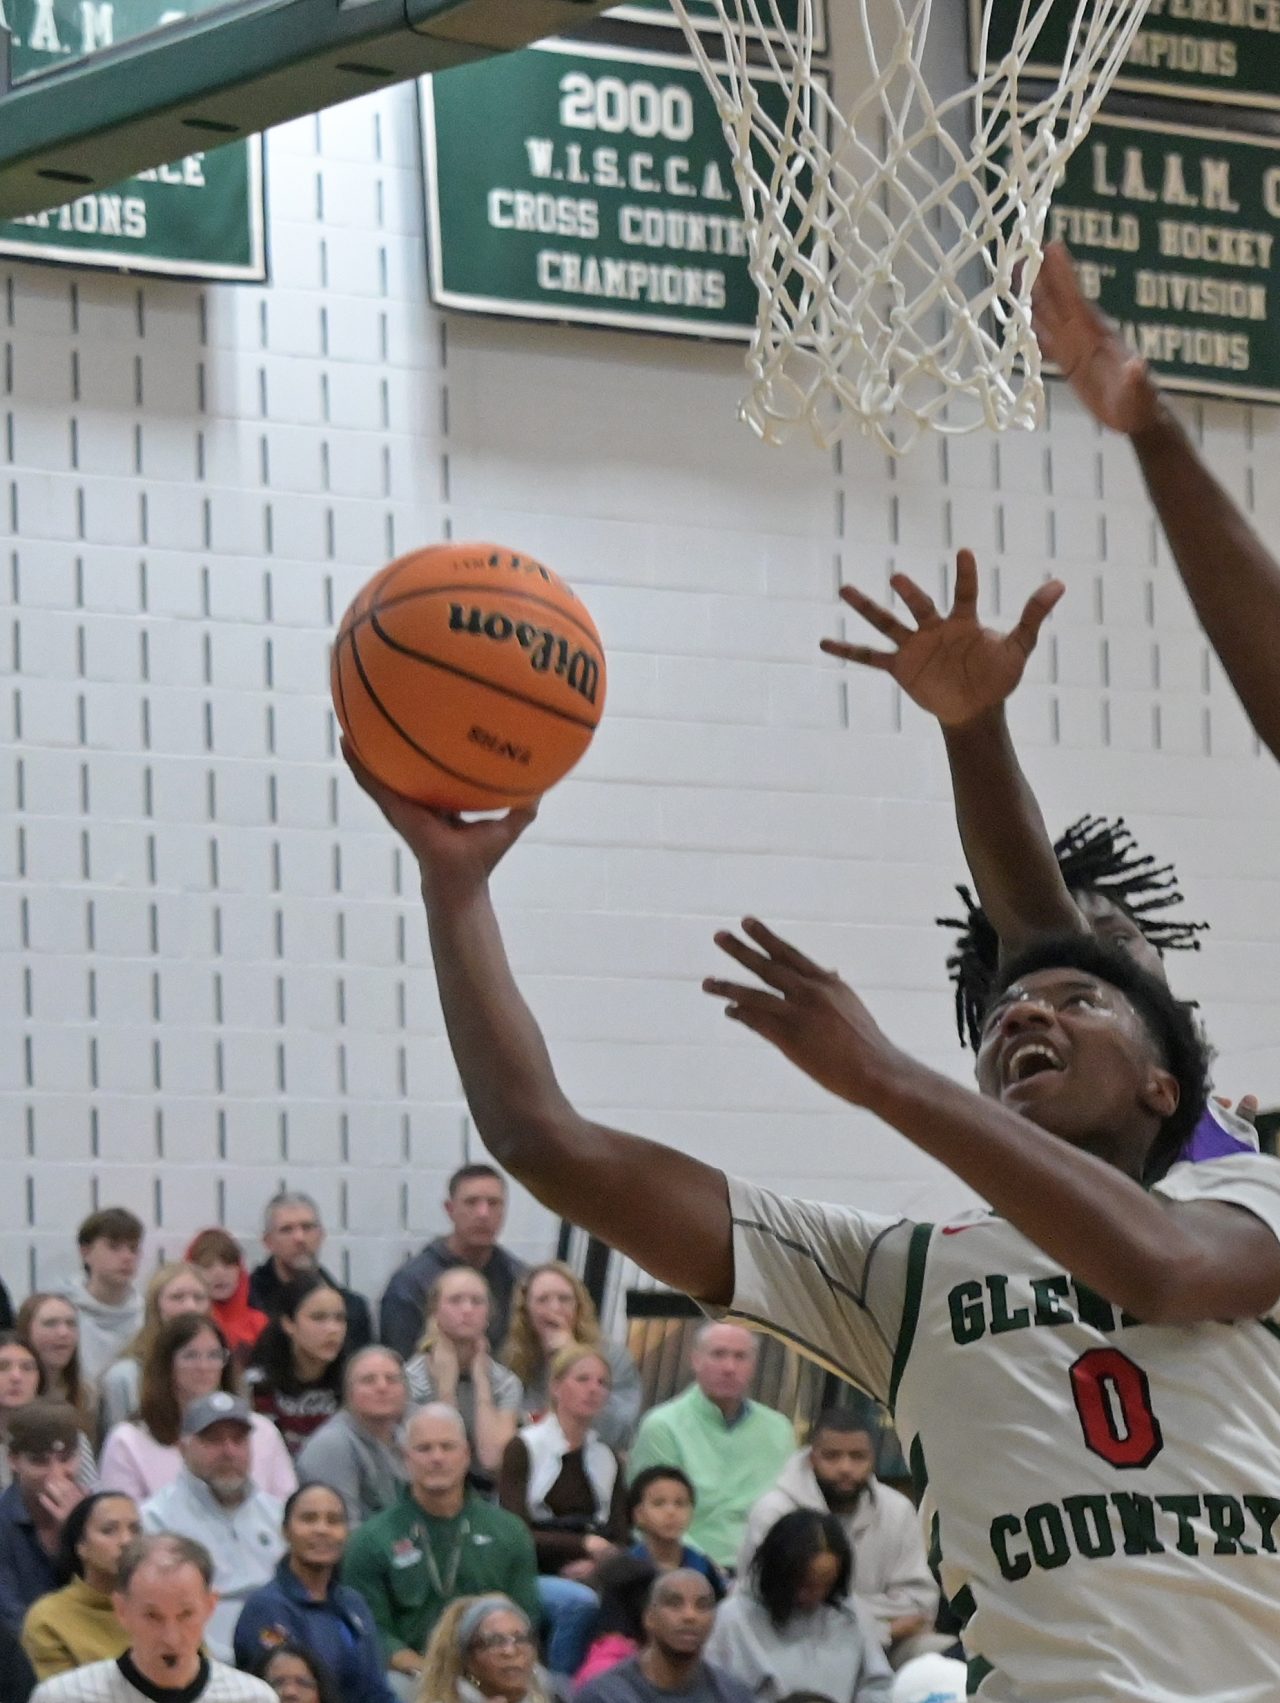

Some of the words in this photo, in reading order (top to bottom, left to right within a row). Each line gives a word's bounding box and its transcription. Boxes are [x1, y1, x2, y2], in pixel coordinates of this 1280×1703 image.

[559, 71, 694, 141] 2000
[525, 138, 732, 200] W.I.S.C.C.A.
[488, 189, 599, 240] CROSS
[618, 204, 750, 257] COUNTR
[1051, 204, 1140, 252] FIELD
[1158, 219, 1274, 268] HOCKEY
[537, 250, 726, 309] CHAMPIONS
[1136, 269, 1267, 321] DIVISION
[1118, 322, 1250, 371] AMPIONS
[449, 601, 600, 706] Wilson
[1069, 1347, 1164, 1469] 0
